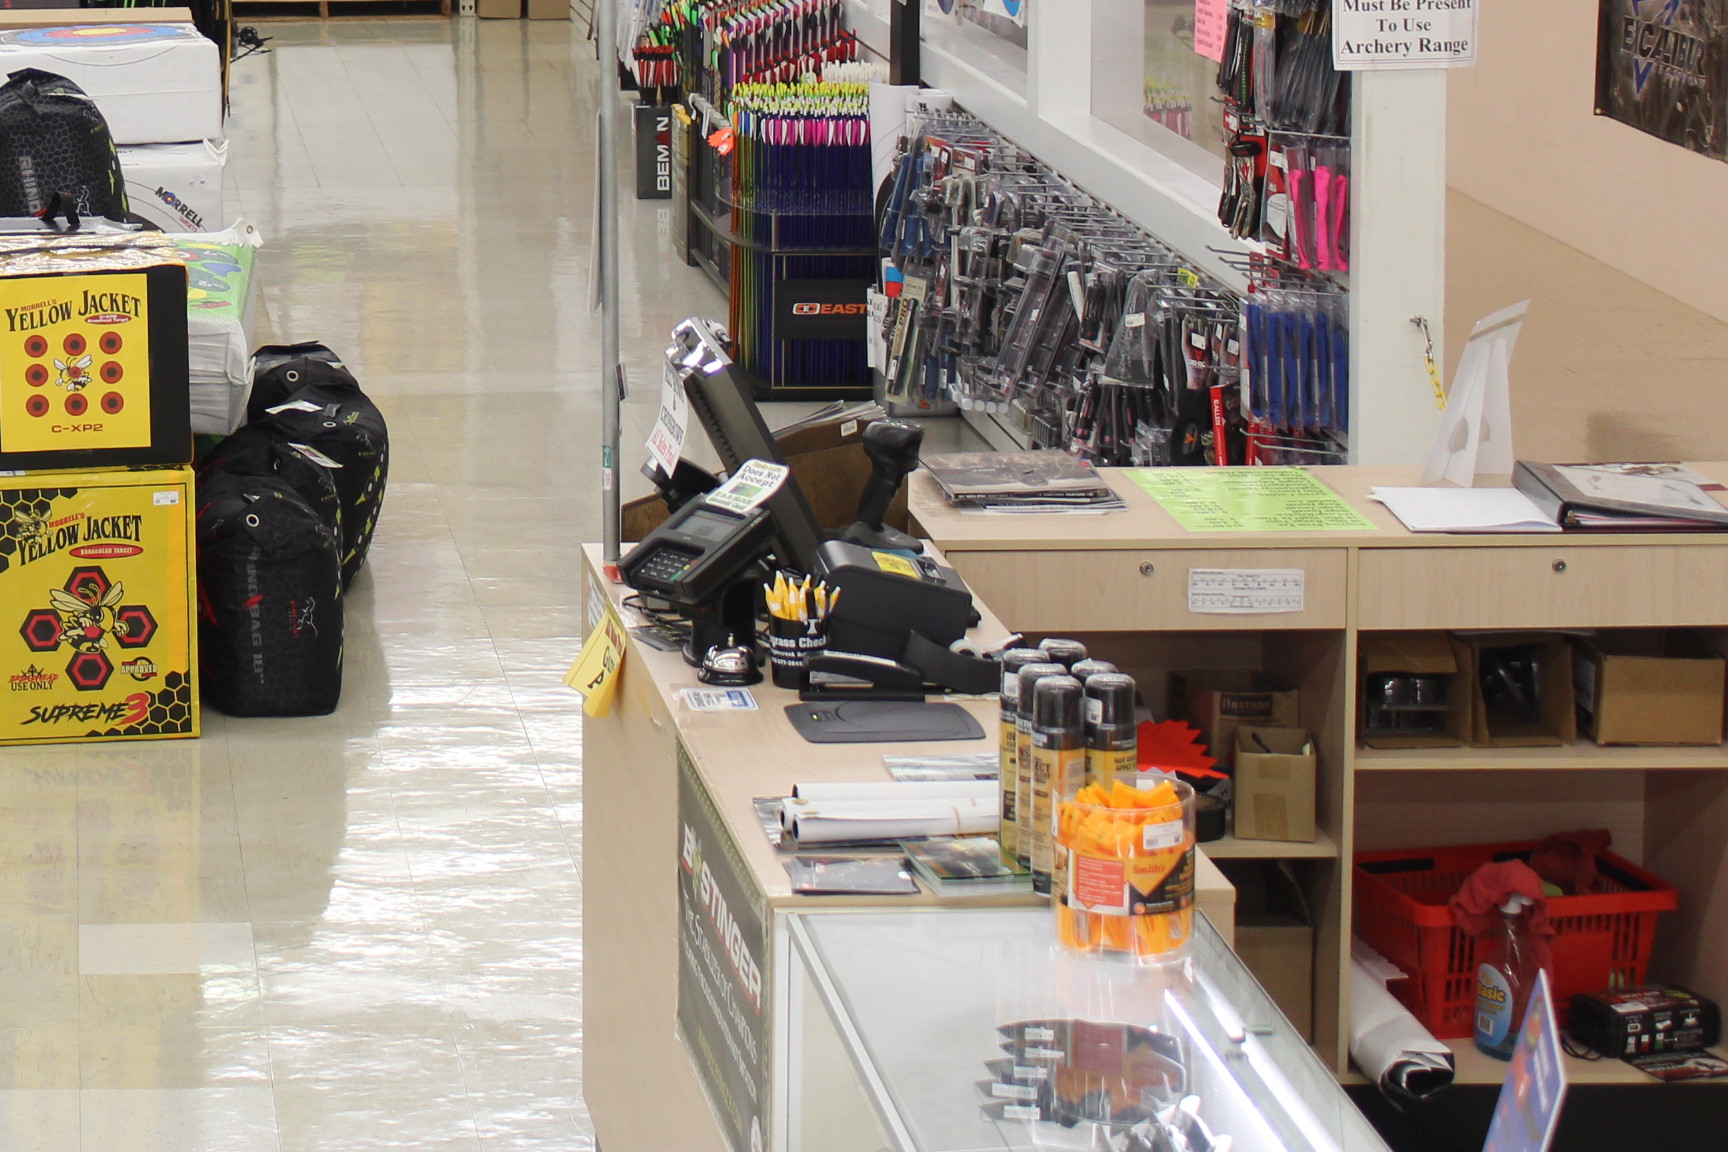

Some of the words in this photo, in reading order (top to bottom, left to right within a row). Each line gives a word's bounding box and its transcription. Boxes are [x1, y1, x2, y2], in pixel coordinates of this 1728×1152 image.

[1376, 18, 1397, 33] To
[1403, 18, 1432, 32] Use
[1341, 38, 1413, 57] Archery
[1419, 37, 1468, 55] Range
[155, 186, 204, 229] MORRELL
[4, 299, 73, 332] YELLOW
[78, 289, 142, 319] JACKET
[20, 298, 57, 312] MORRELL'S
[821, 302, 868, 314] EAST
[51, 423, 104, 433] C-XP2
[660, 405, 683, 446] CROSSBOWS
[737, 473, 775, 488] Accept
[743, 465, 763, 477] Does
[765, 471, 781, 481] Not
[48, 512, 86, 528] MORRELL'S
[18, 522, 79, 566] YELLOW
[83, 515, 142, 542] JACKET
[121, 665, 158, 674] APPROVED
[11, 682, 29, 692] USE
[30, 681, 55, 691] ONLY
[1132, 863, 1165, 875] Smith's
[700, 859, 761, 1009] STINGER
